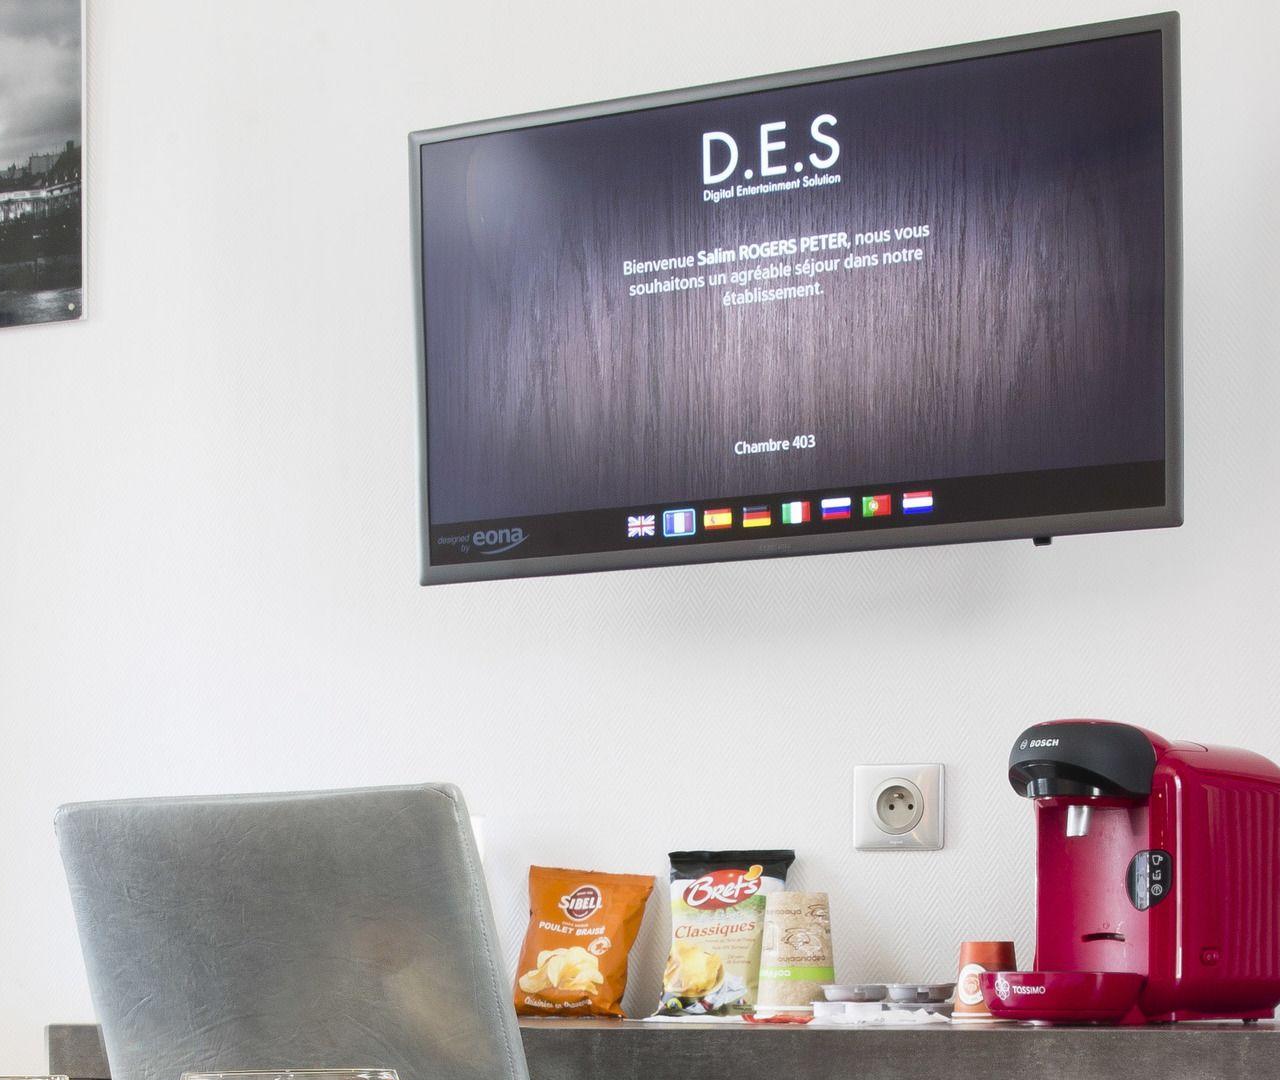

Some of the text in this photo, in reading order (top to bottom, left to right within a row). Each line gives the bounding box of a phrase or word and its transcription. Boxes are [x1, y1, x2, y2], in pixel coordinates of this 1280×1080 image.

[702, 113, 840, 185] D.E.S
[703, 173, 841, 203] Digital Entertainment Solution
[623, 225, 930, 276] Bienvenue Salim ROGERS PETER, nous vous
[629, 247, 923, 297] souhaitons un agréable séjour dans notre
[723, 282, 824, 306] établissement.
[734, 434, 816, 455] Chambre 403
[437, 534, 470, 545] designed
[472, 527, 524, 546] eona
[461, 544, 470, 553] by
[1030, 738, 1060, 748] BOSCH
[539, 921, 574, 934] POULET
[674, 921, 757, 940] Classiques
[1012, 984, 1046, 995] TASSIMO
